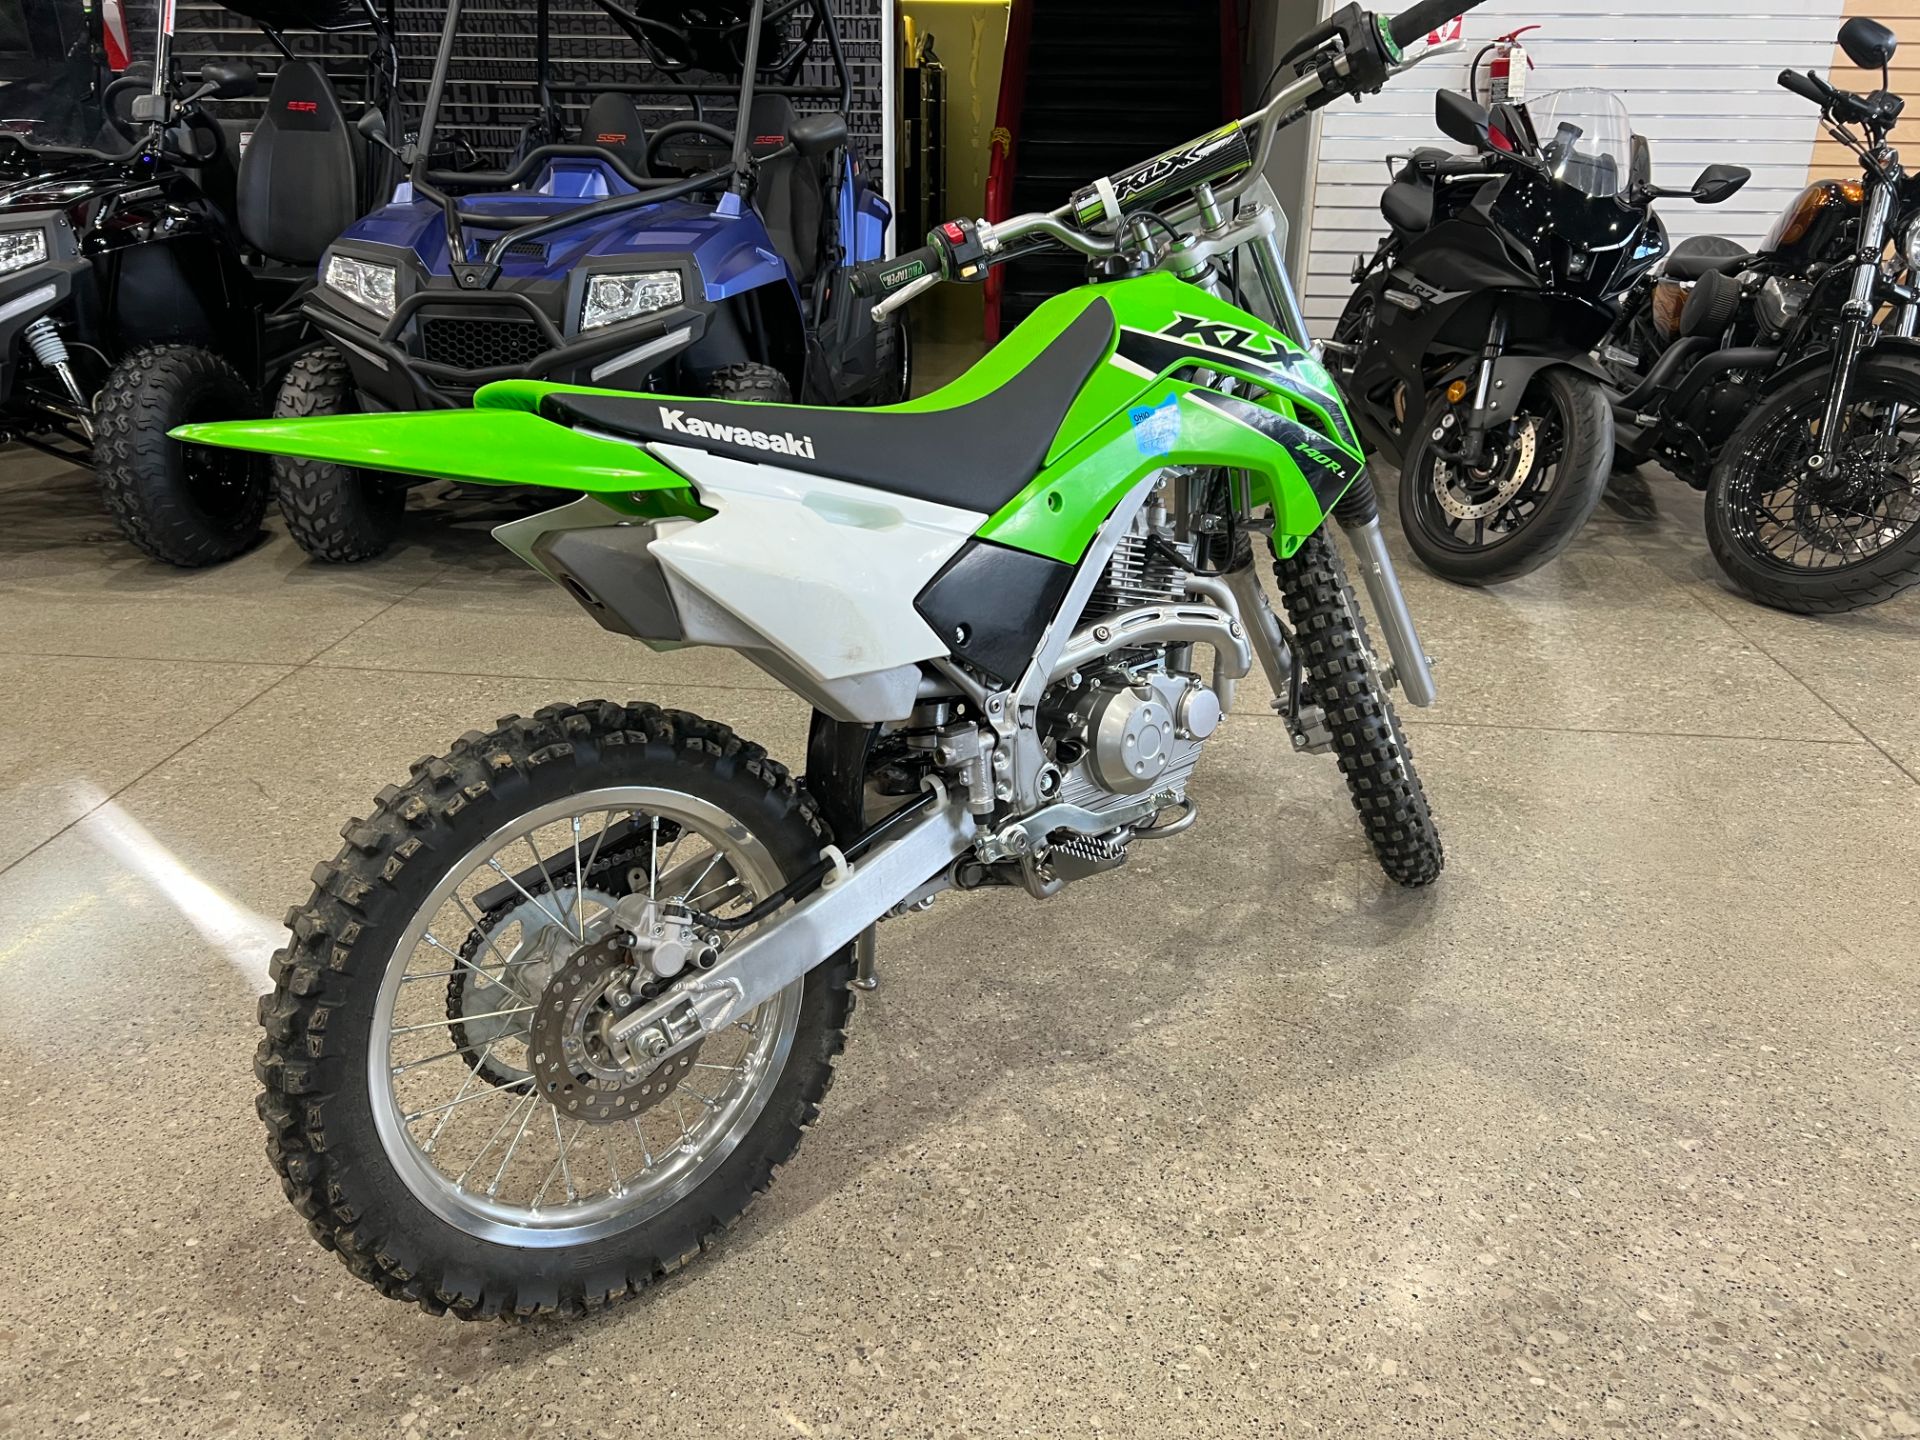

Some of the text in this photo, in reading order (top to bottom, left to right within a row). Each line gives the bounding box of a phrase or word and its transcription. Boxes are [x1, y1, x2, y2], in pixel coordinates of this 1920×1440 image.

[596, 133, 627, 146] SSR
[753, 135, 785, 147] SSR
[1157, 311, 1305, 372] KLX
[659, 406, 815, 460] Kawasaki
